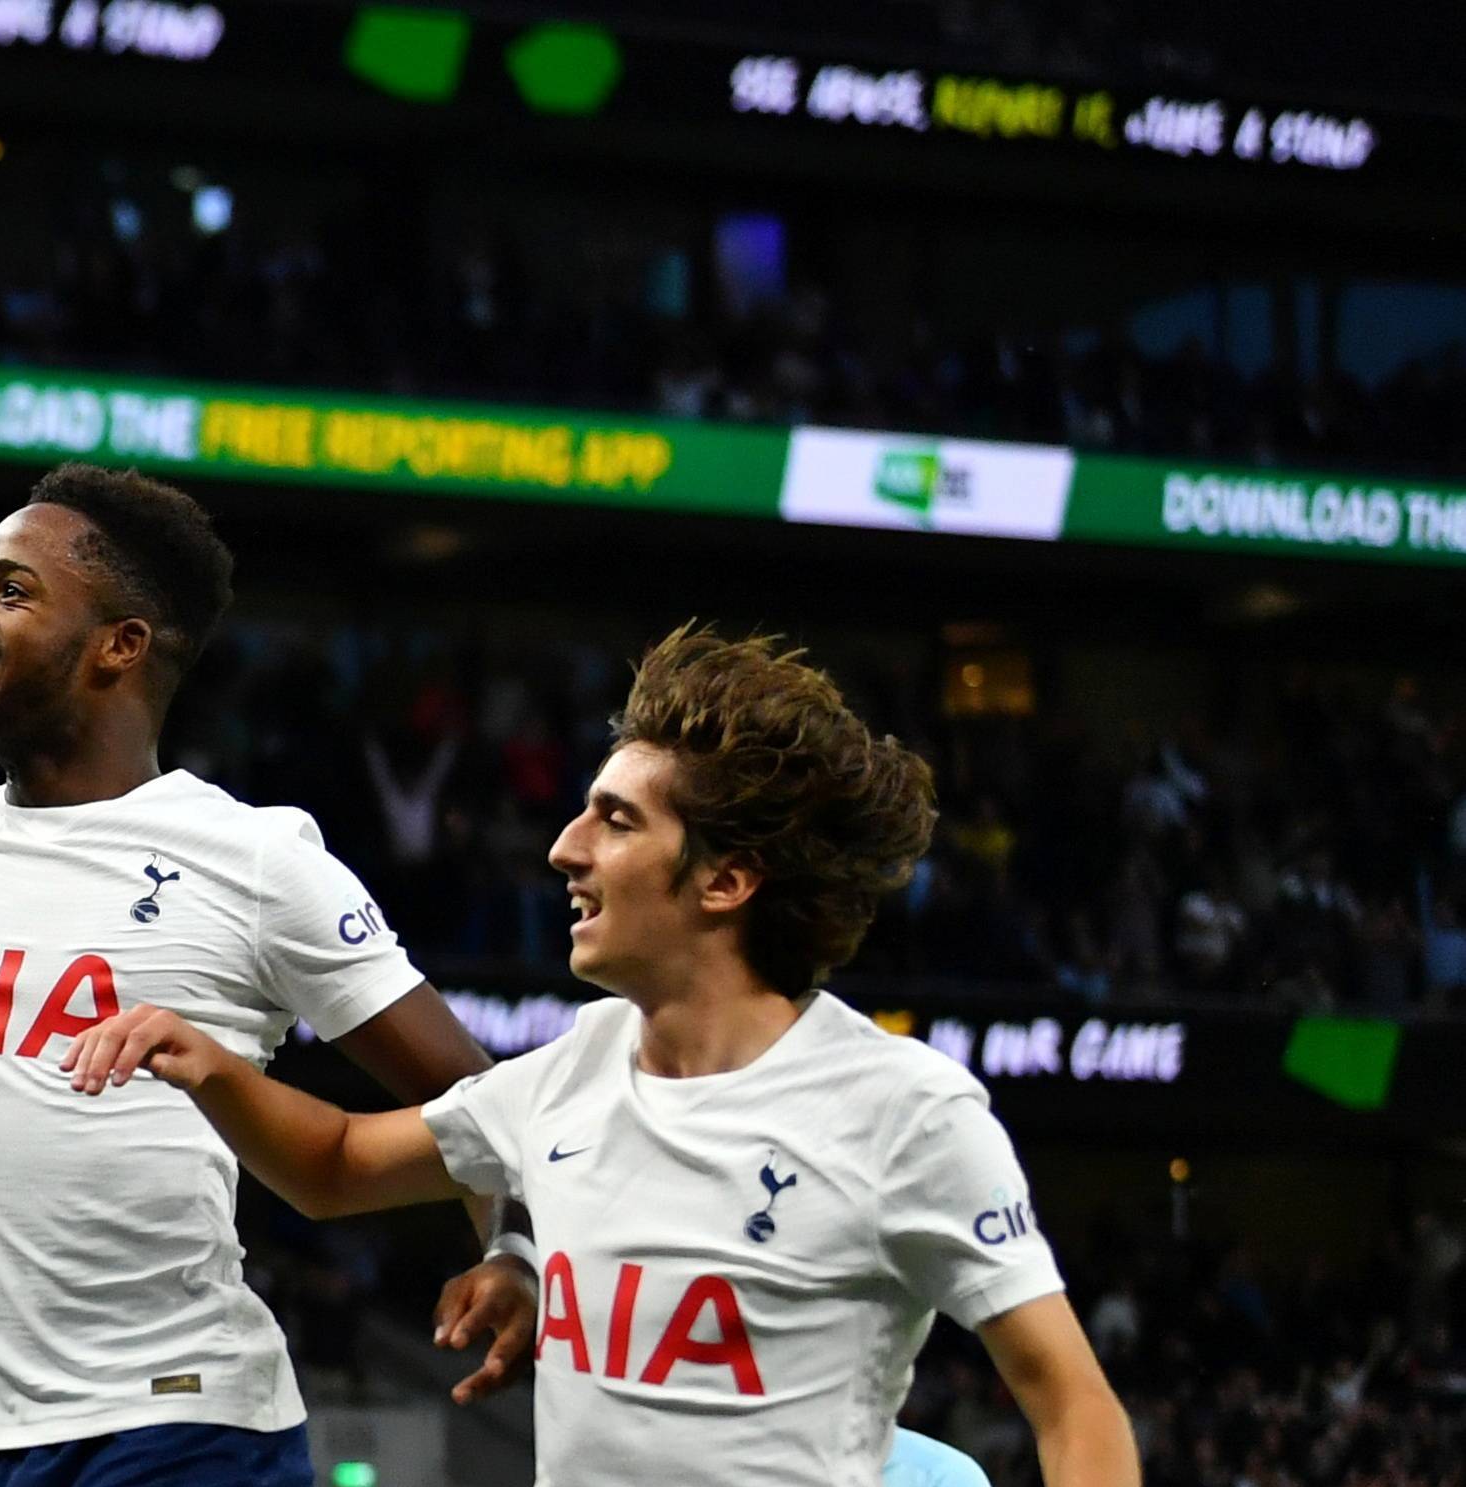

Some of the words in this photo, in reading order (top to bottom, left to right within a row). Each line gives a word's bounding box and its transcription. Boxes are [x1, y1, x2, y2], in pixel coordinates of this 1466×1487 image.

[109, 390, 197, 460] THE
[202, 402, 316, 468] FREE
[321, 410, 575, 488] REPORTING
[578, 432, 671, 490] APP
[1162, 473, 1402, 548] DOWNLOAD
[535, 1251, 765, 1396] AIA
